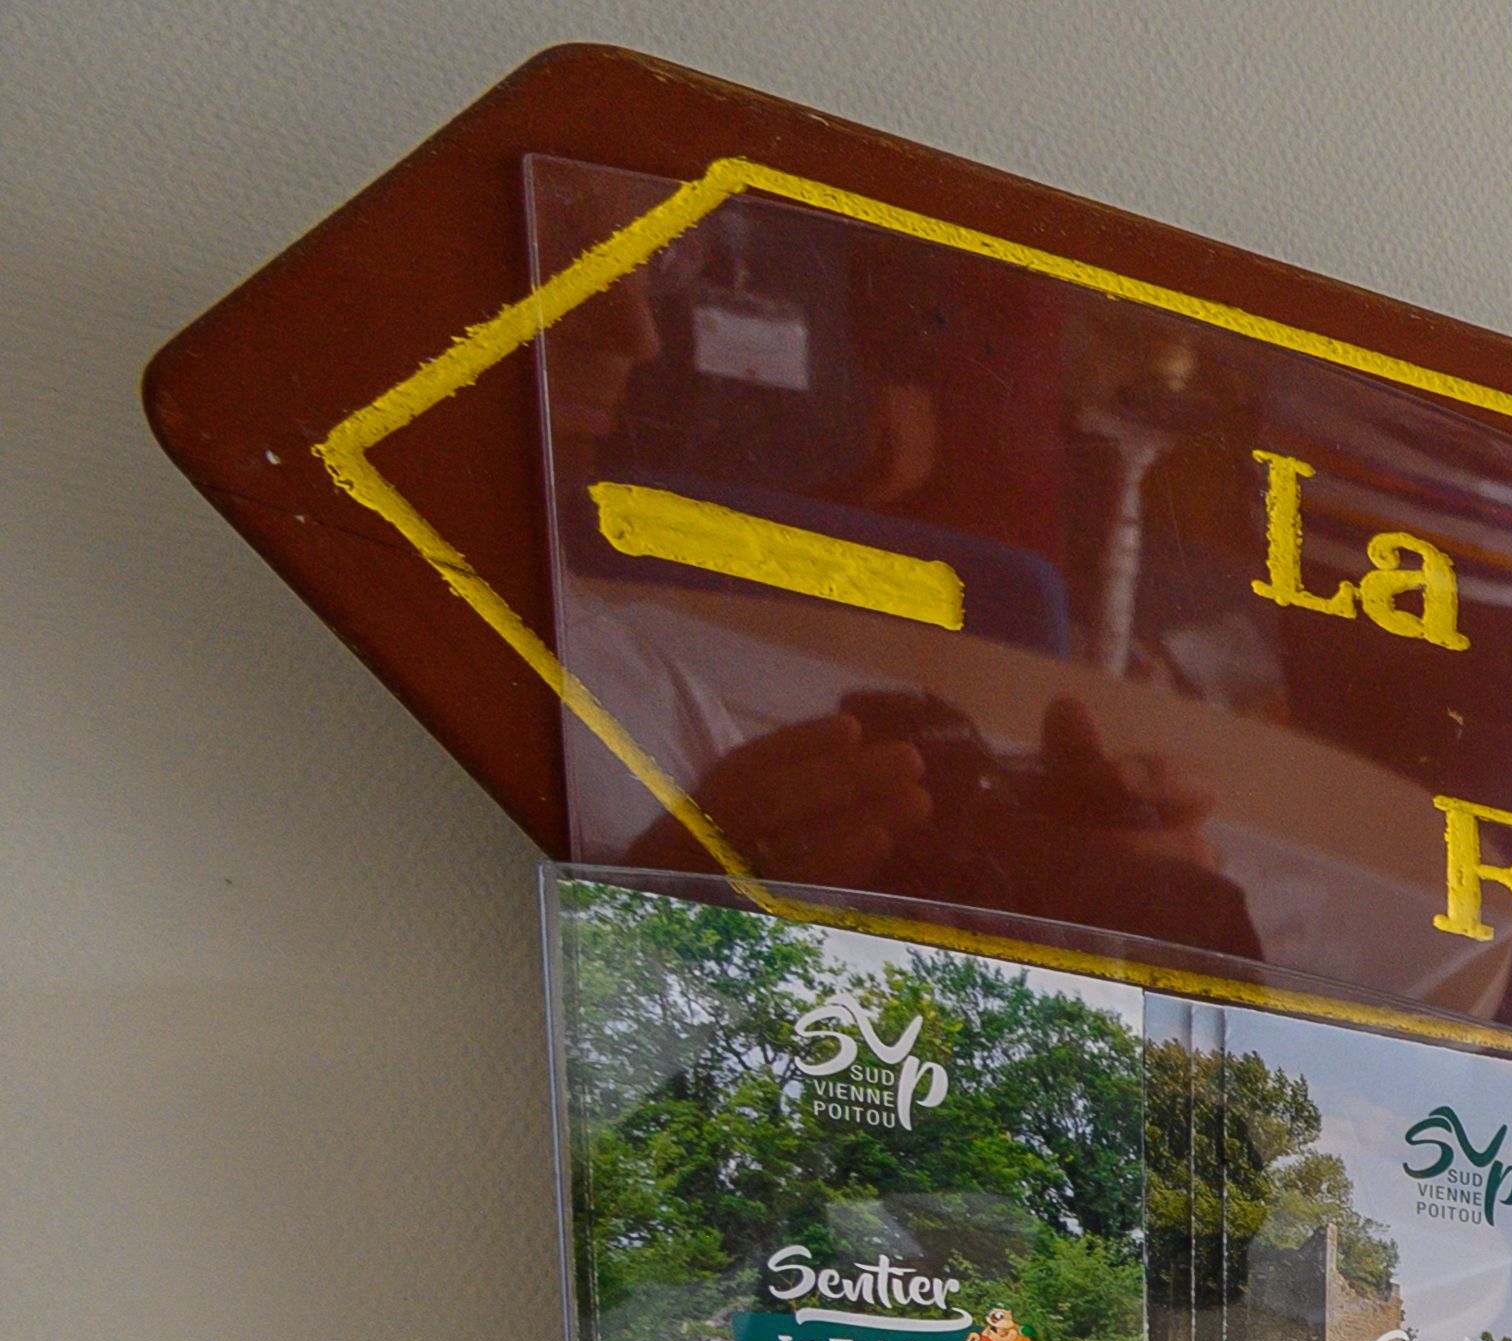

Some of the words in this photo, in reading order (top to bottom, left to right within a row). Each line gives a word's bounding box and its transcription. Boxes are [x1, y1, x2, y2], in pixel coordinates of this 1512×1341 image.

[1251, 449, 1472, 651] La
[850, 1063, 895, 1086] SUD
[813, 1079, 895, 1108] VIENNE
[813, 1100, 895, 1129] POITOU
[767, 1245, 961, 1310] Sentier
